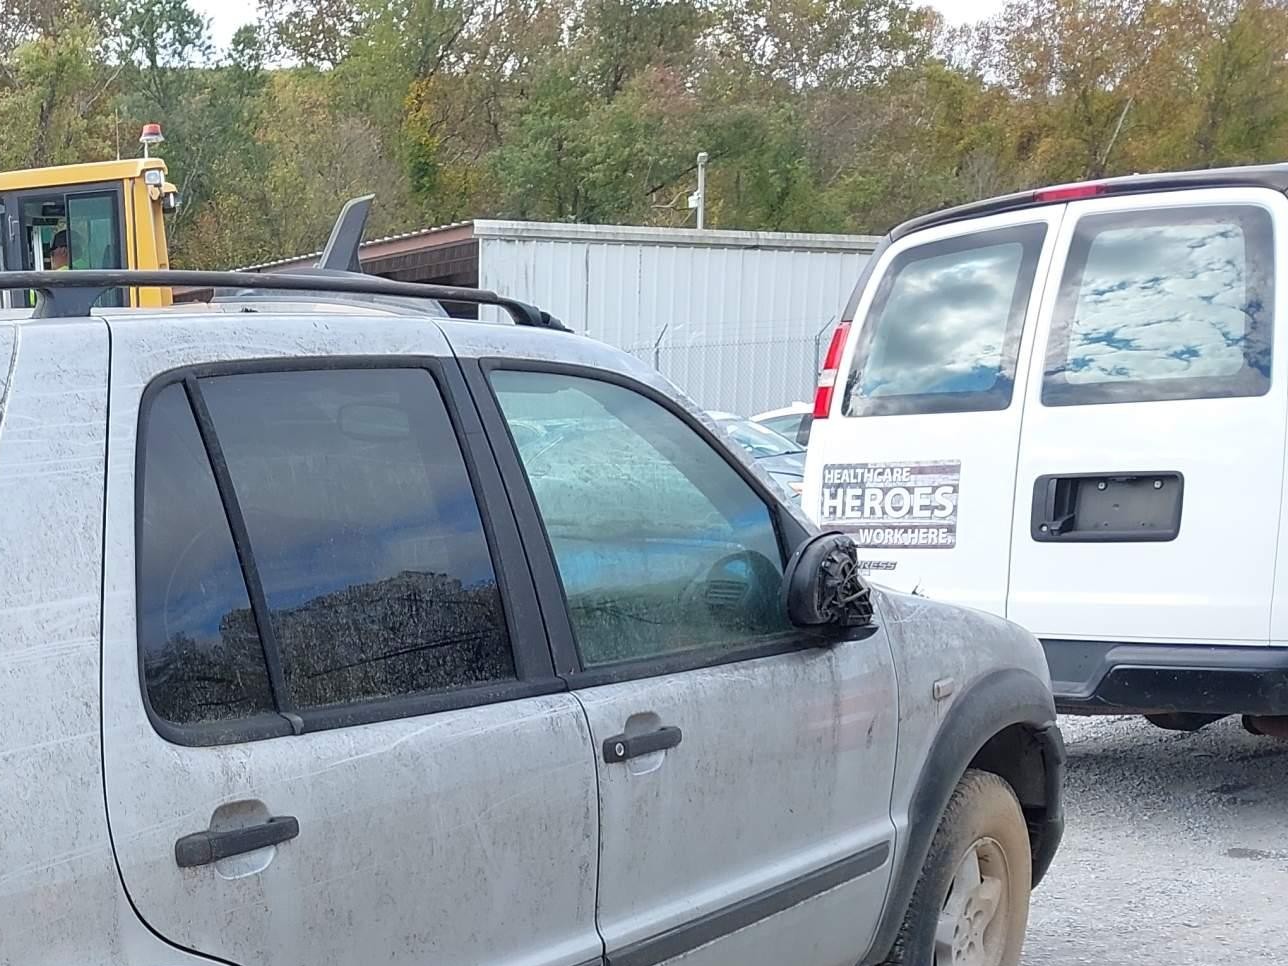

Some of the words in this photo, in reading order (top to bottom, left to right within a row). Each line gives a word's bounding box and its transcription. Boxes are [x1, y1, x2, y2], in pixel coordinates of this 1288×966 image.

[824, 467, 911, 484] HEALTHCARE
[823, 486, 955, 519] HEROES
[859, 529, 904, 545] WORK
